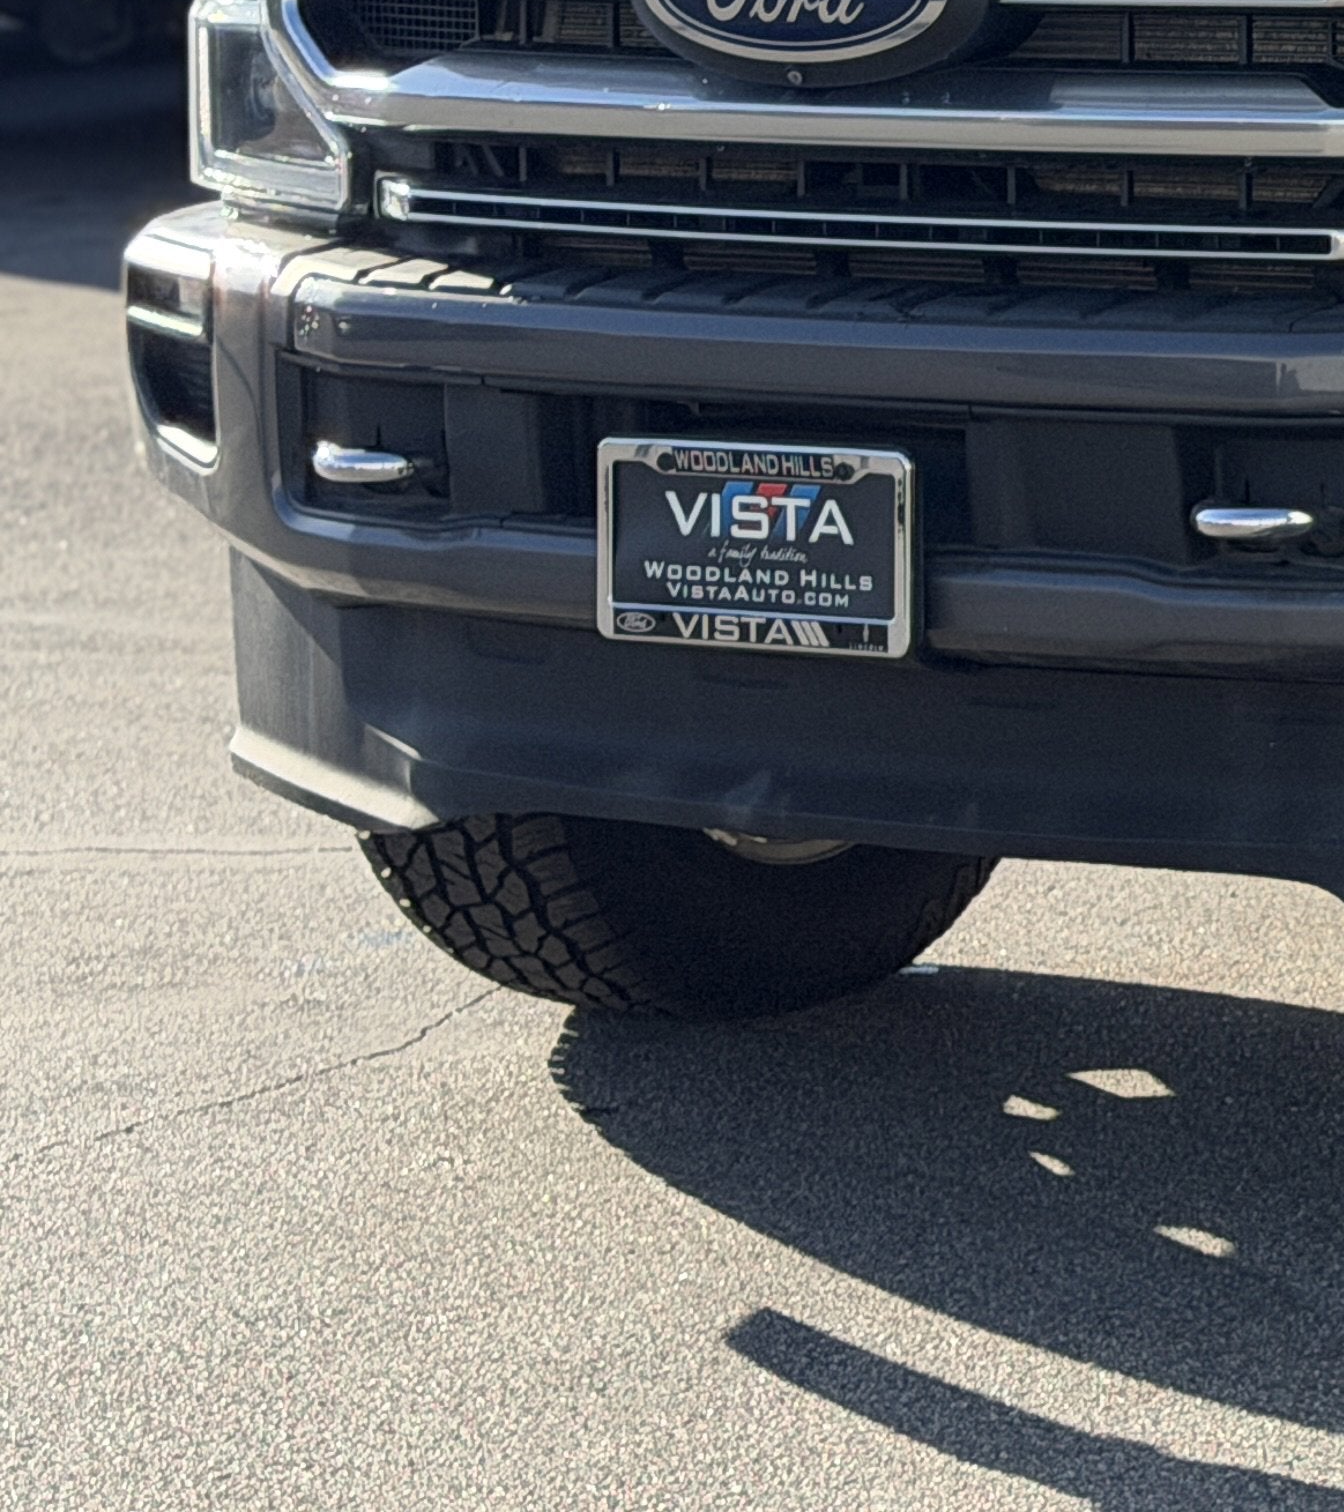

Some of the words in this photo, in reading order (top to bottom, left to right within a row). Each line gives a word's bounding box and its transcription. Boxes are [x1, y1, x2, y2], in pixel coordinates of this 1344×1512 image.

[674, 449, 779, 475] WOODLAND
[782, 455, 835, 477] HILLS
[665, 490, 854, 545] VISTA
[644, 560, 789, 586] WOODLAND
[800, 569, 873, 591] HILLS
[671, 612, 794, 646] VISTA
